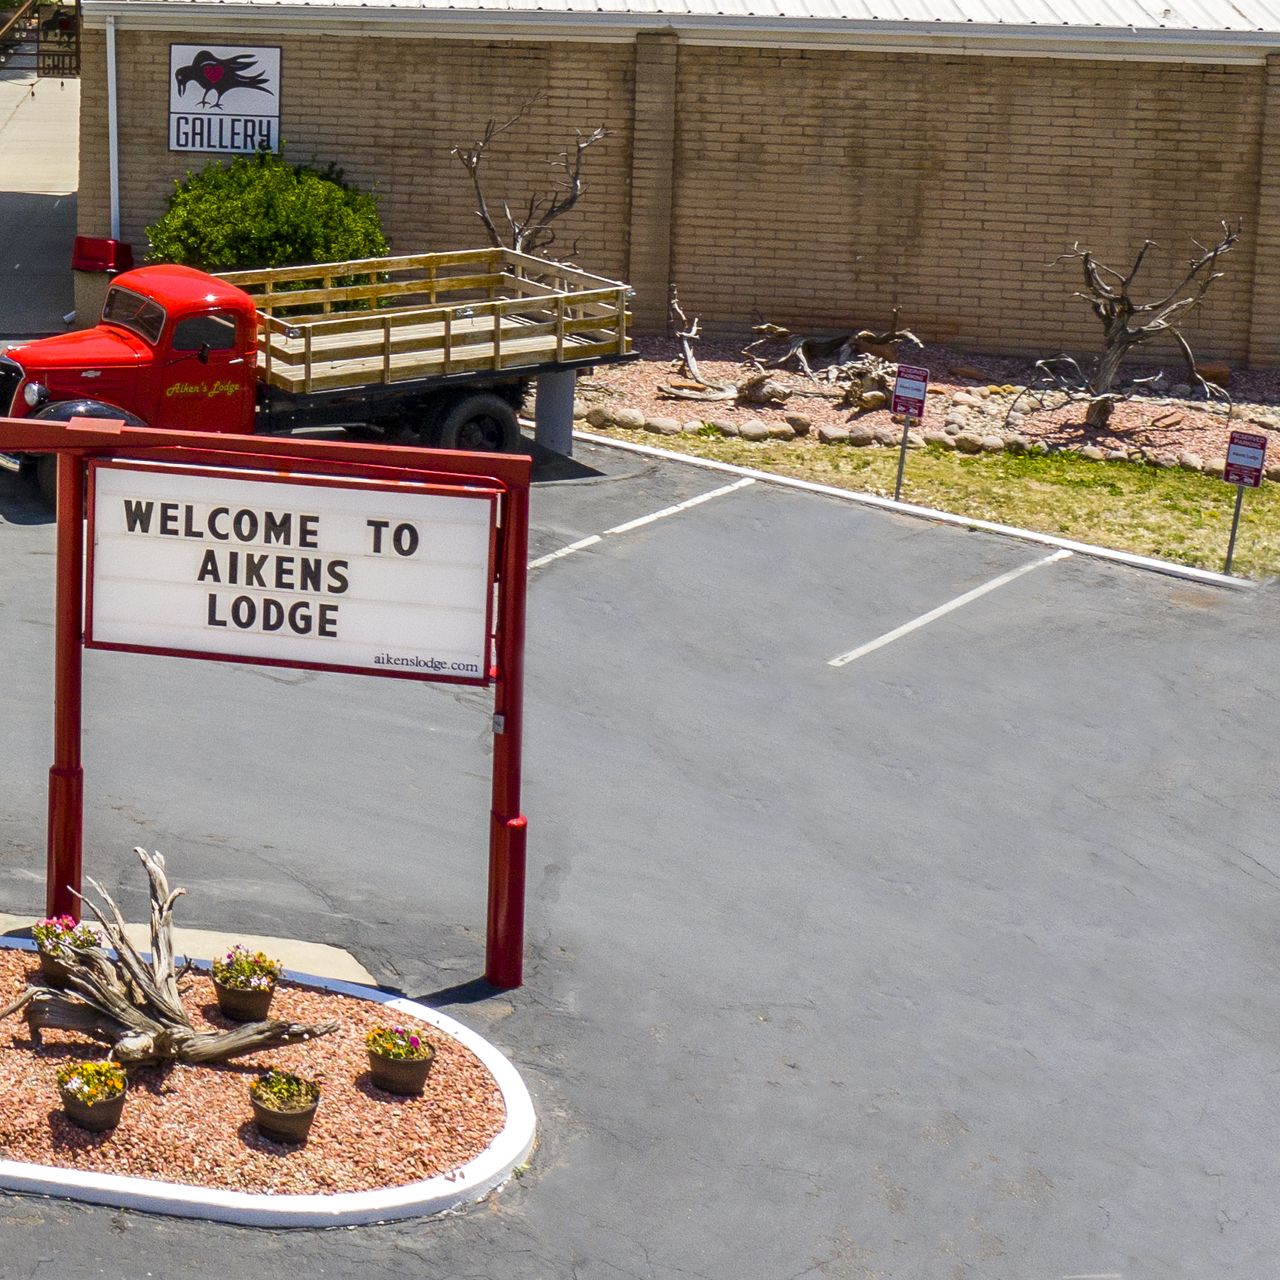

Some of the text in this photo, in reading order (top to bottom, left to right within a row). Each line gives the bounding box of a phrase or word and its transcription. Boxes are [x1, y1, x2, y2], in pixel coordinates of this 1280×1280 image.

[176, 116, 271, 151] GALLERY
[166, 380, 240, 398] Aiken's Lodge
[123, 499, 419, 557] WELCOME TO
[197, 549, 350, 595] AIKENS
[207, 593, 339, 638] LODGE
[373, 653, 479, 673] aikenslodge.com
